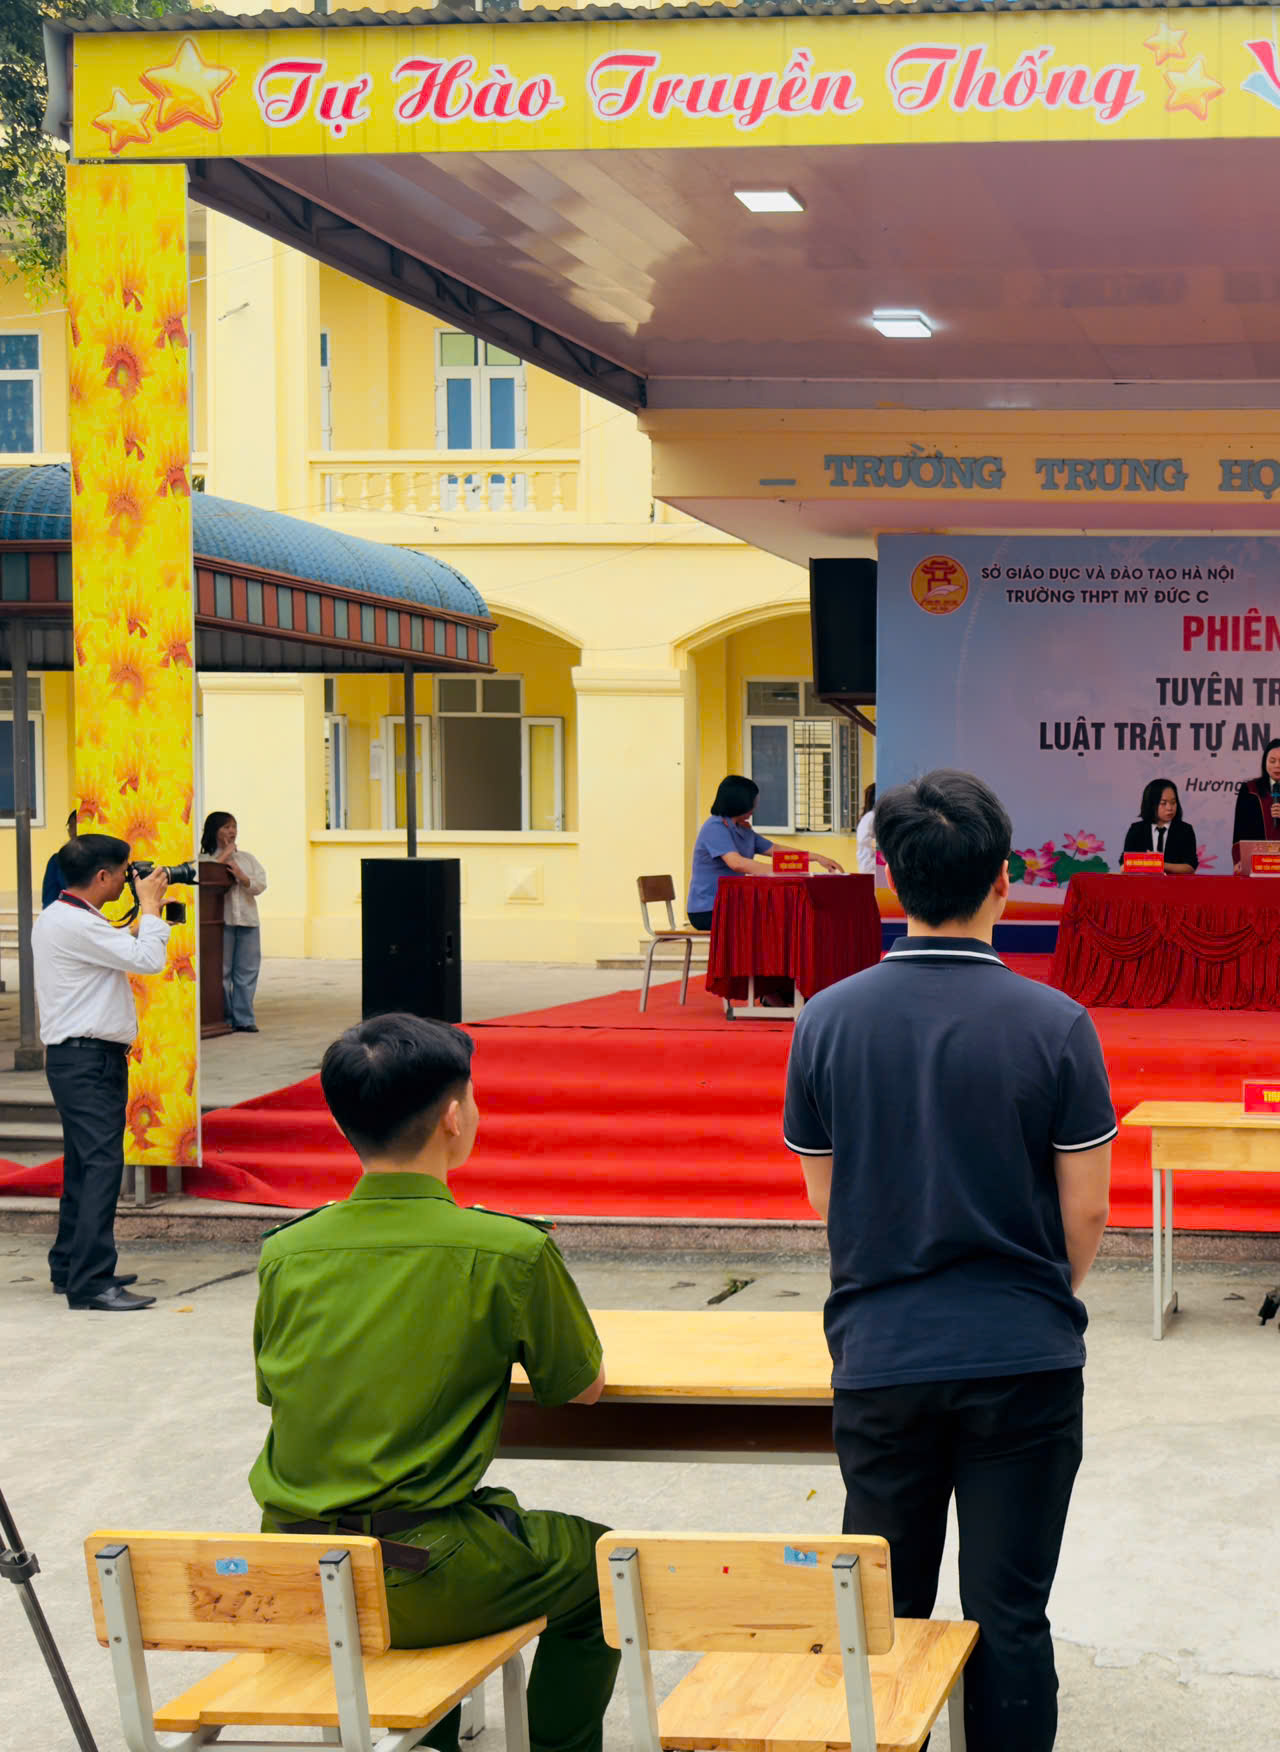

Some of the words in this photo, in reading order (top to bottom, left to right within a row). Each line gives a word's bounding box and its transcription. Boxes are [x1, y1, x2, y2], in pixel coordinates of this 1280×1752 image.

[258, 61, 369, 134] Tự
[396, 59, 561, 119] Hào
[590, 51, 860, 126] Truyền
[889, 46, 1141, 120] Thống
[823, 443, 1006, 489] TRƯỜNG
[1035, 457, 1189, 491] TRUNG
[981, 564, 1002, 580] SỞ
[1006, 565, 1045, 580] GIÁO
[1049, 567, 1081, 584] DỤC
[1085, 564, 1106, 580] VÀ
[1110, 564, 1144, 580] ĐÀO
[1148, 567, 1178, 584] TẠO
[1182, 564, 1204, 580] HÀ
[1208, 564, 1235, 584] NỘI
[1006, 586, 1075, 604] TRƯỜNG
[1080, 590, 1118, 604] THPT
[1124, 586, 1149, 604] MỸ
[1154, 585, 1191, 604] ĐỨC
[1196, 590, 1210, 604] C
[1156, 671, 1243, 706] TUYÊN
[1039, 716, 1106, 757] LUẬT
[1114, 716, 1181, 758] TRẬT
[1190, 719, 1227, 758] TỰ
[1231, 722, 1271, 752] AN
